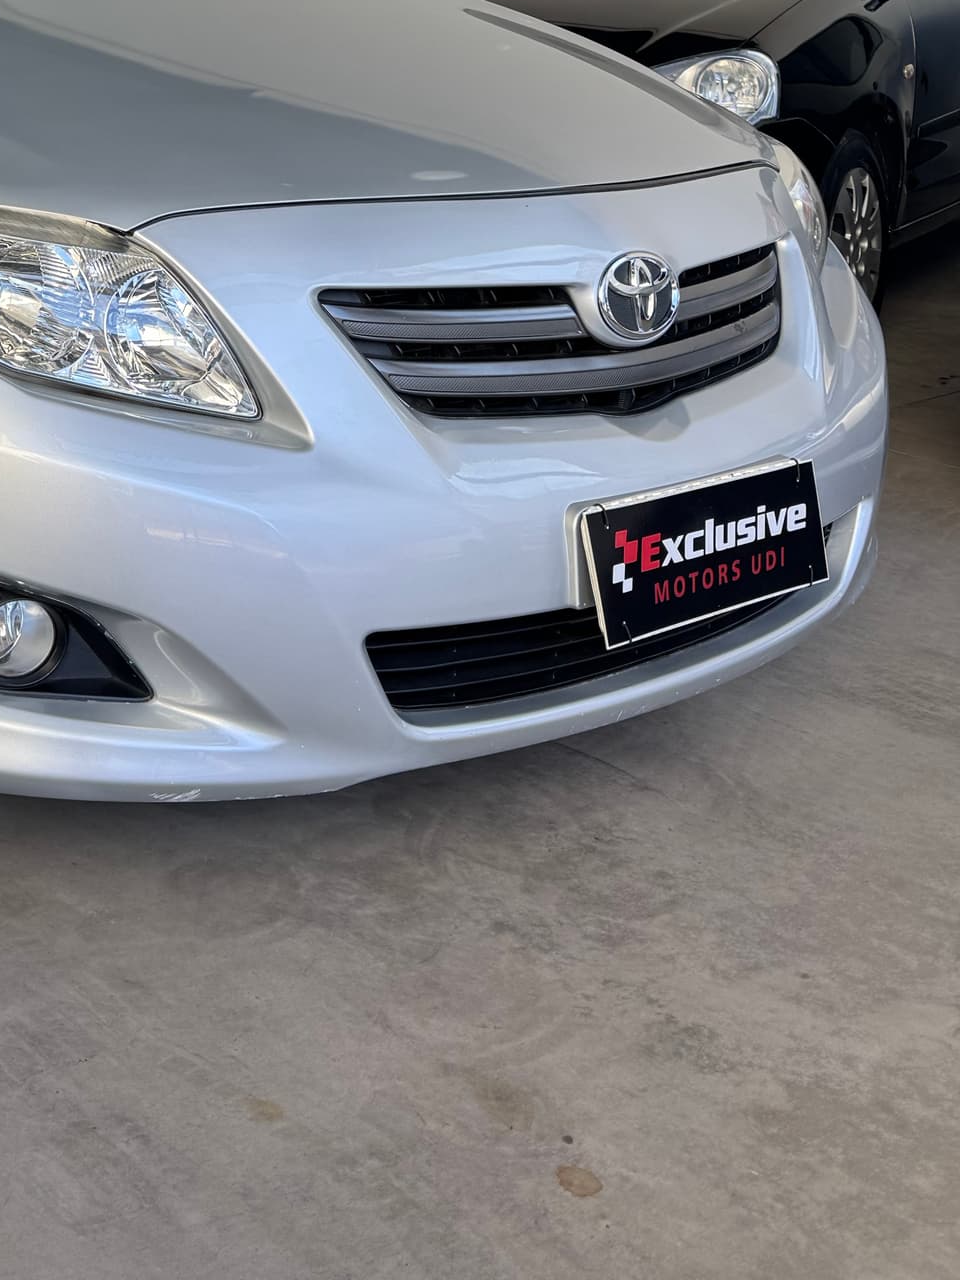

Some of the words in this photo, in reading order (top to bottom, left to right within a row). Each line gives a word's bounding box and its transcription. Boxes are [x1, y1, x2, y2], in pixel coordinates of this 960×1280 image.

[641, 503, 807, 572] Exclusive
[654, 559, 741, 604] MOTORS
[751, 546, 785, 575] UDI
